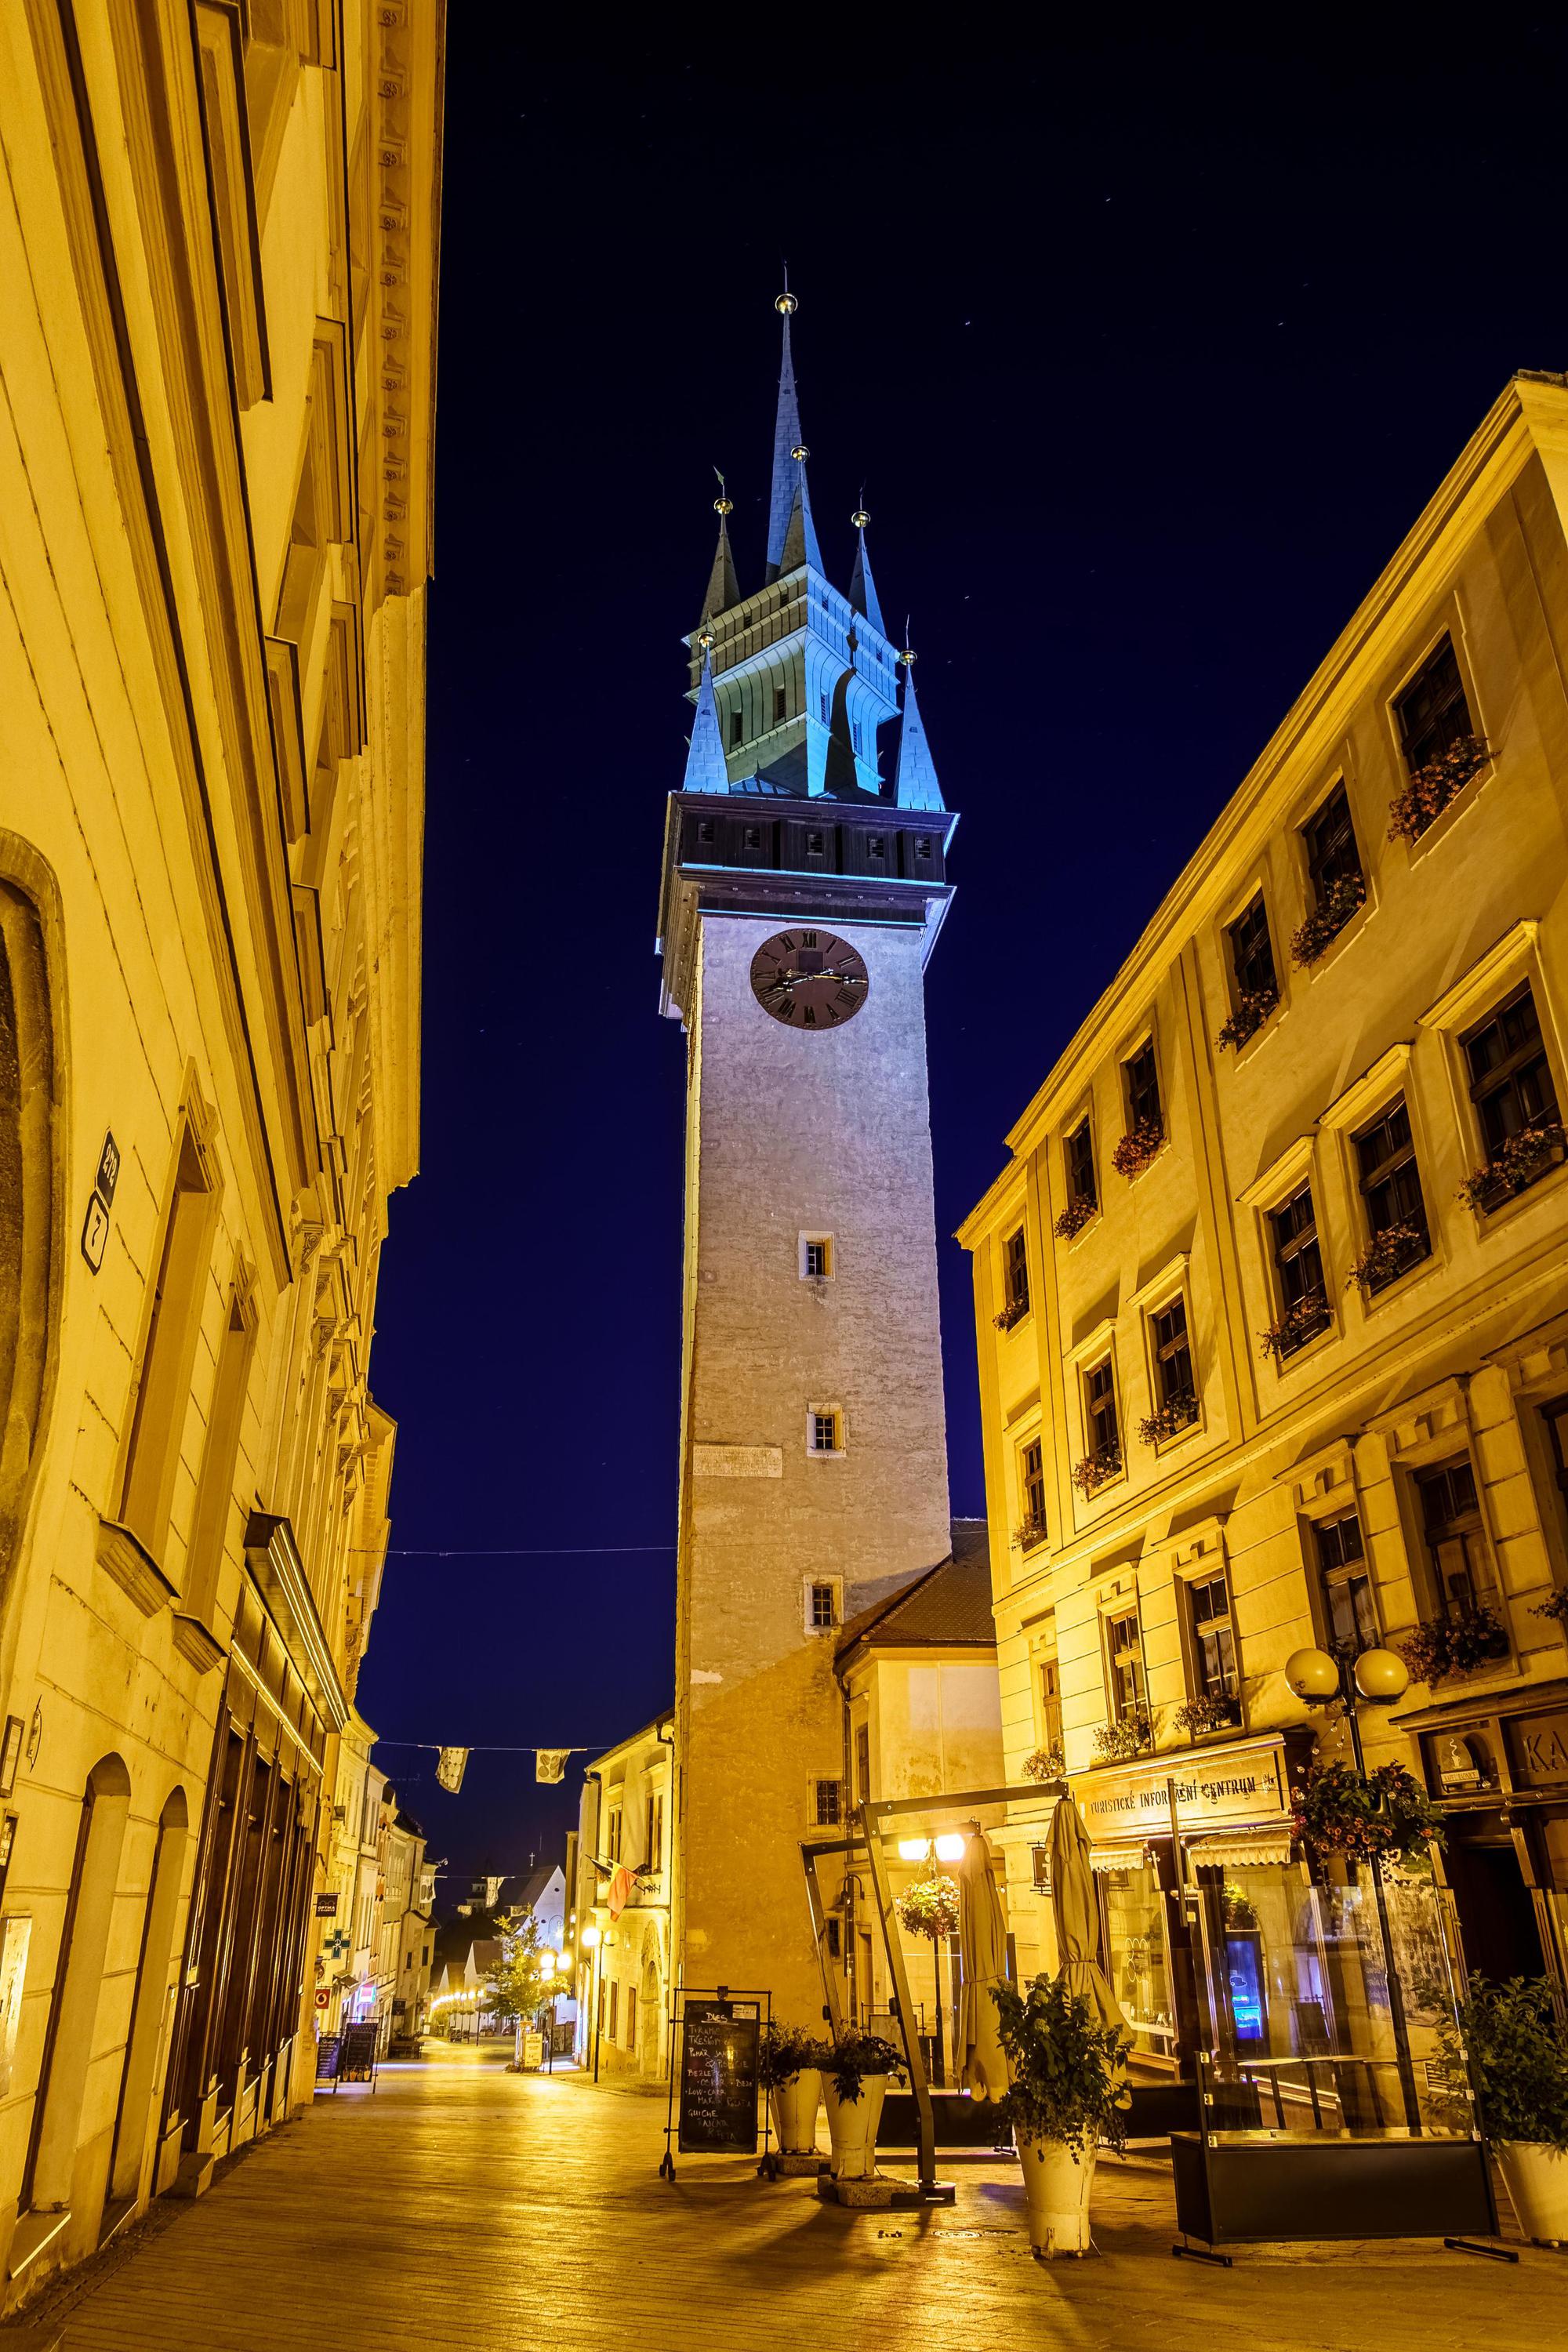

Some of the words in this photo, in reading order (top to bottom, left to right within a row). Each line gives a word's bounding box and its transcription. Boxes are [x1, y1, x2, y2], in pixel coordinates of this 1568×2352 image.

[103, 1143, 118, 1188] 272
[1091, 1790, 1136, 1814] TURISTICKÉ
[1140, 1779, 1197, 1808] INFORAČNÍ
[1201, 1777, 1256, 1798] CENTRUM
